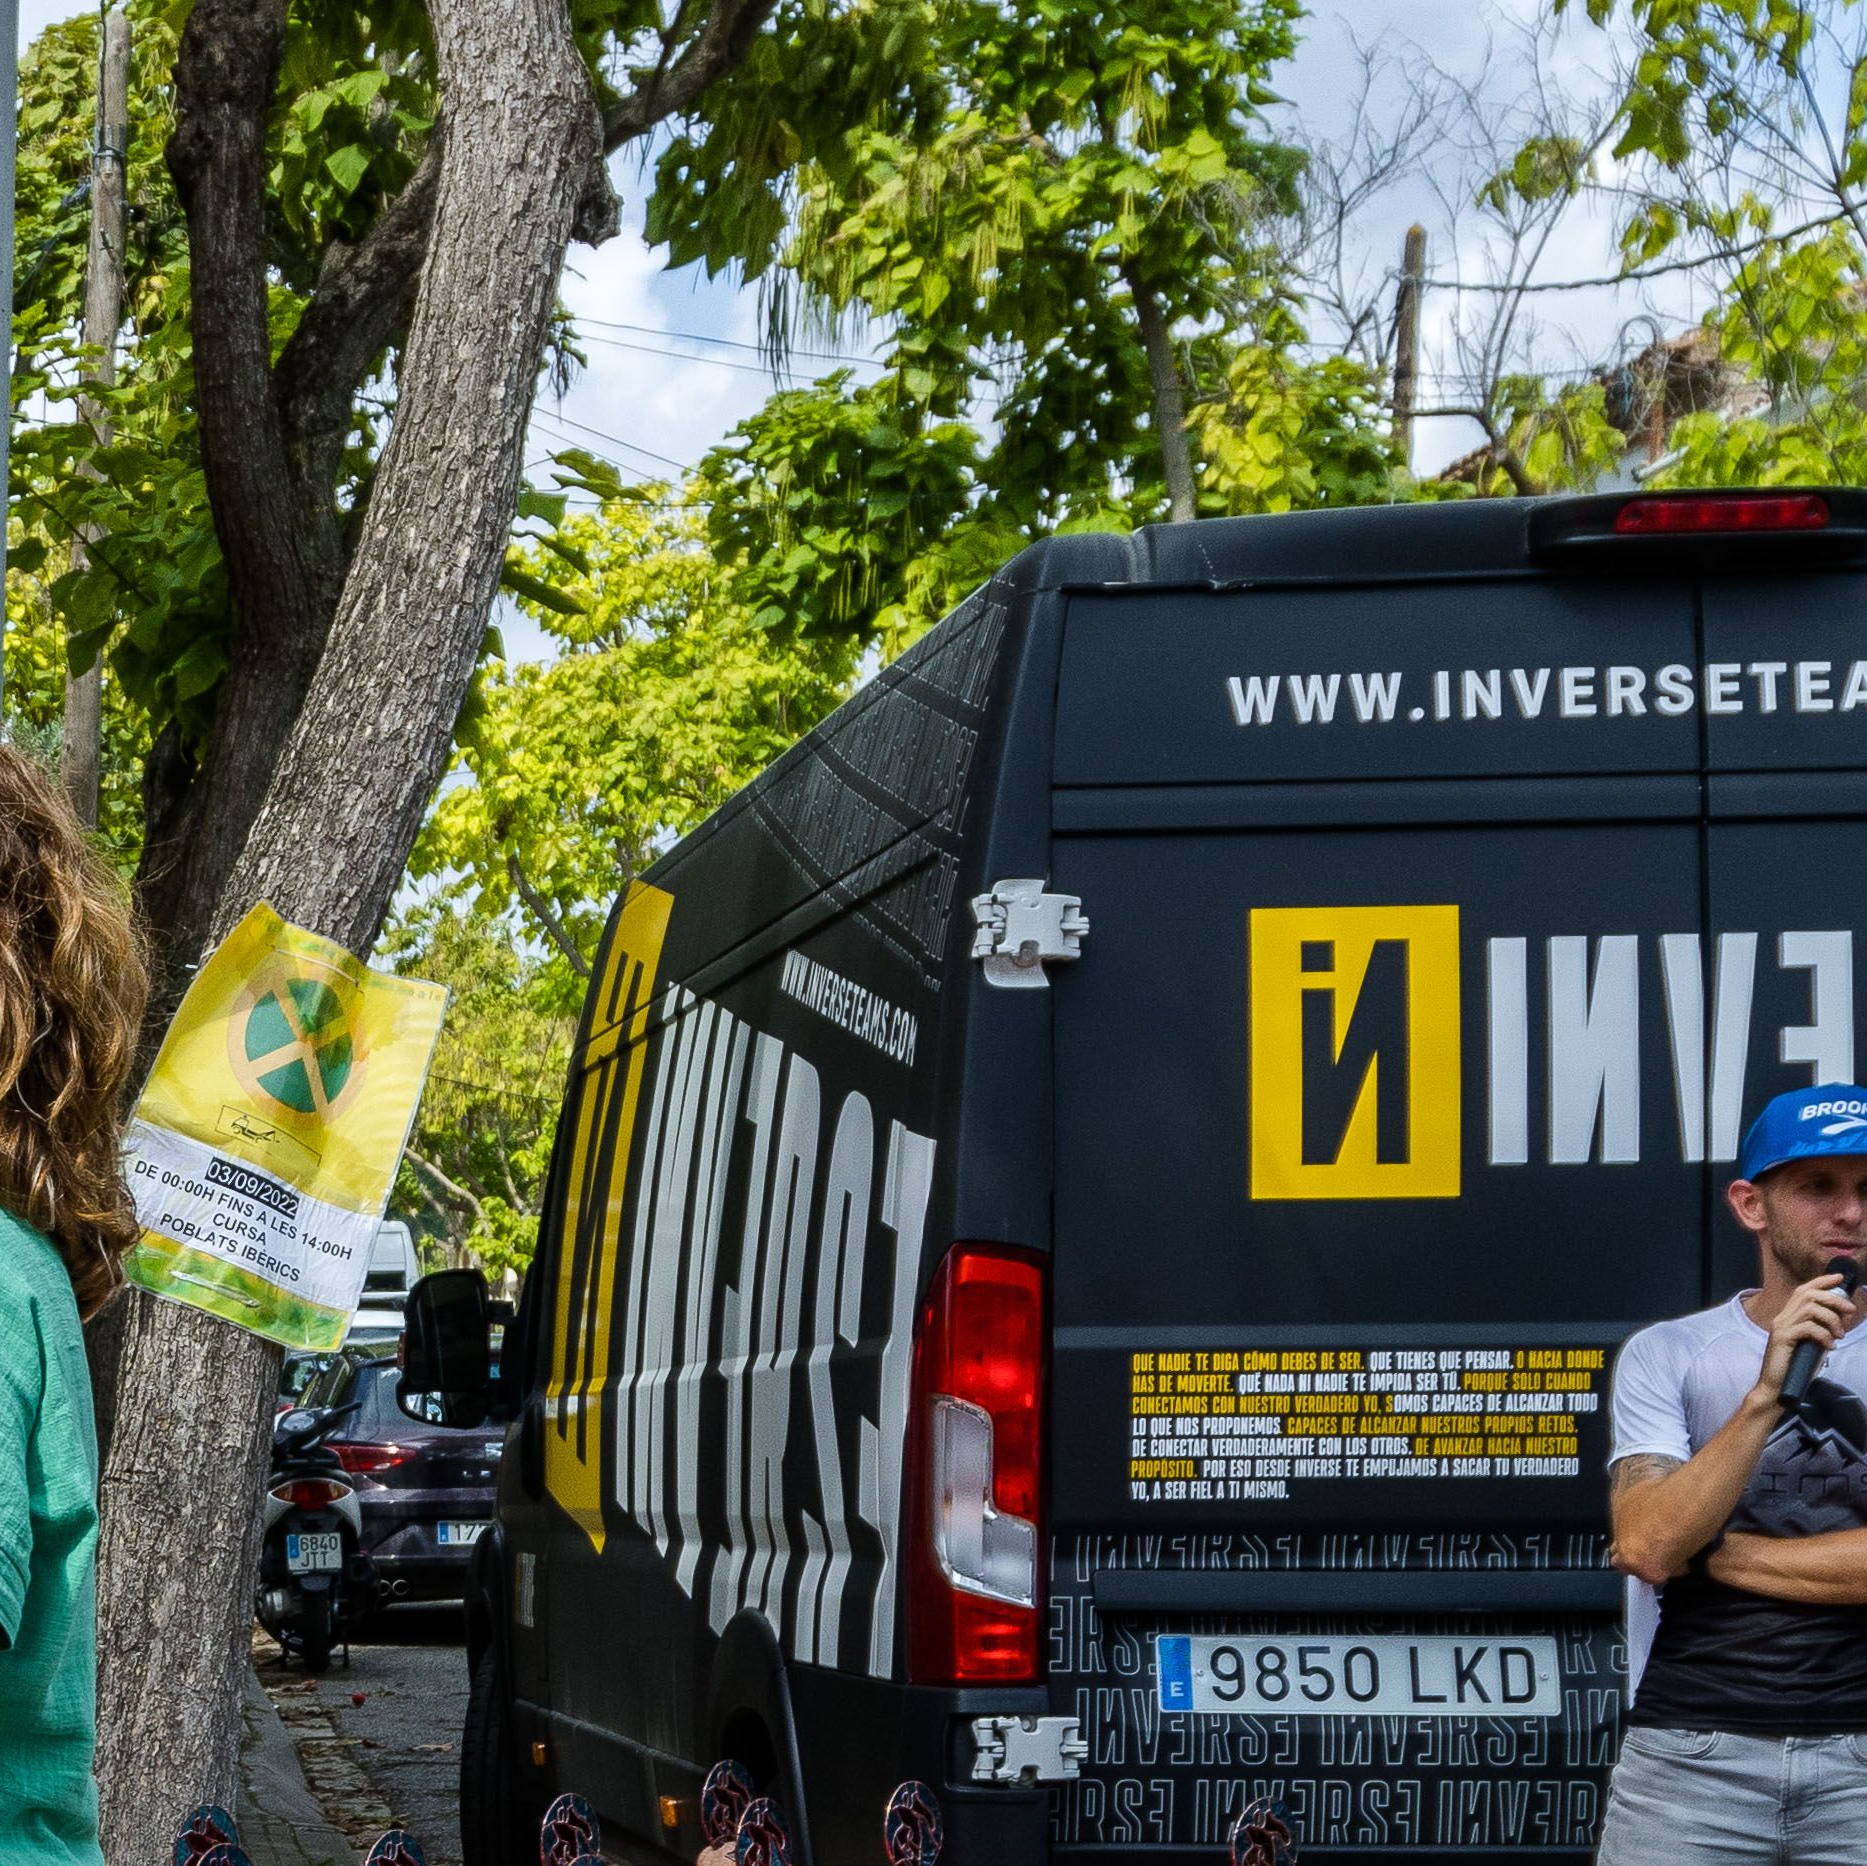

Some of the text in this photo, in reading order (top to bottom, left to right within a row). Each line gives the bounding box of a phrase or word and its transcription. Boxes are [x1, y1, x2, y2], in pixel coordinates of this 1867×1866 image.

[781, 949, 918, 1068] WWW.INVERSETEAMS.COM
[207, 1160, 299, 1217] 03/09/2022
[135, 1160, 353, 1260] DE 00:00H FINS A LES 14:00H
[160, 1213, 237, 1253] POBLATS
[213, 1213, 267, 1246] CURSA
[1133, 1353, 1154, 1373] QUE
[1159, 1353, 1191, 1371] NADIE
[1196, 1353, 1208, 1371] TE
[1213, 1353, 1239, 1371] DIGA
[1282, 1352, 1316, 1370] DEBES
[1321, 1352, 1334, 1370] DE
[1339, 1352, 1364, 1370] SER.
[1370, 1352, 1392, 1372] QUE
[1396, 1352, 1435, 1370] TIENES
[1440, 1351, 1461, 1371] QUE
[1465, 1351, 1514, 1369] PENSAR.
[1517, 1351, 1524, 1368] O
[1529, 1350, 1562, 1368] HACIA
[1567, 1350, 1604, 1368] DONDE
[1133, 1374, 1155, 1393] HAS
[1159, 1374, 1173, 1393] DE
[1177, 1374, 1234, 1393] MOVERTE.
[1265, 1374, 1295, 1392] NADA
[1299, 1374, 1311, 1392] NI
[1315, 1374, 1349, 1392] NADIE
[1353, 1373, 1366, 1391] TE
[1370, 1373, 1412, 1391] IMPIDA
[1416, 1373, 1439, 1391] SER
[1464, 1372, 1509, 1392] PORQUE
[1513, 1372, 1541, 1390] SOLO
[1546, 1372, 1591, 1390] CUANDO
[1132, 1394, 1598, 1414] CONECTAMOS CON NUESTRO VERDADERO YO, SOMOS CAPACES DE ALCANZAR TODO
[1132, 1415, 1578, 1437] LO QUE NOS PROPONEMOS. CAPACES DE ALCANZAR NUESTROS PROPIOS RETOS.
[1132, 1437, 1578, 1456] DE CONECTAR VERDADERAMENTE CON LOS OTROS. DE AVANZAR HACIA NUESTRO
[1203, 1460, 1226, 1478] POR
[1230, 1460, 1251, 1478] ESO
[1255, 1460, 1290, 1477] DESDE
[1295, 1459, 1341, 1477] INVERSE
[1345, 1459, 1359, 1477] TE
[1363, 1458, 1437, 1476] EMPUJAMOS
[1441, 1458, 1449, 1476] A
[1453, 1458, 1490, 1476] SACAR
[1495, 1458, 1510, 1475] TU
[1514, 1458, 1579, 1475] VERDADERO
[1131, 1481, 1289, 1501] YO, A SER FIEL A TI MISMO.
[300, 1535, 339, 1551] 6840
[301, 1551, 329, 1567] JTT
[1170, 1681, 1185, 1697] E
[1209, 1645, 1379, 1702] 9850
[1409, 1645, 1537, 1703] LKD
